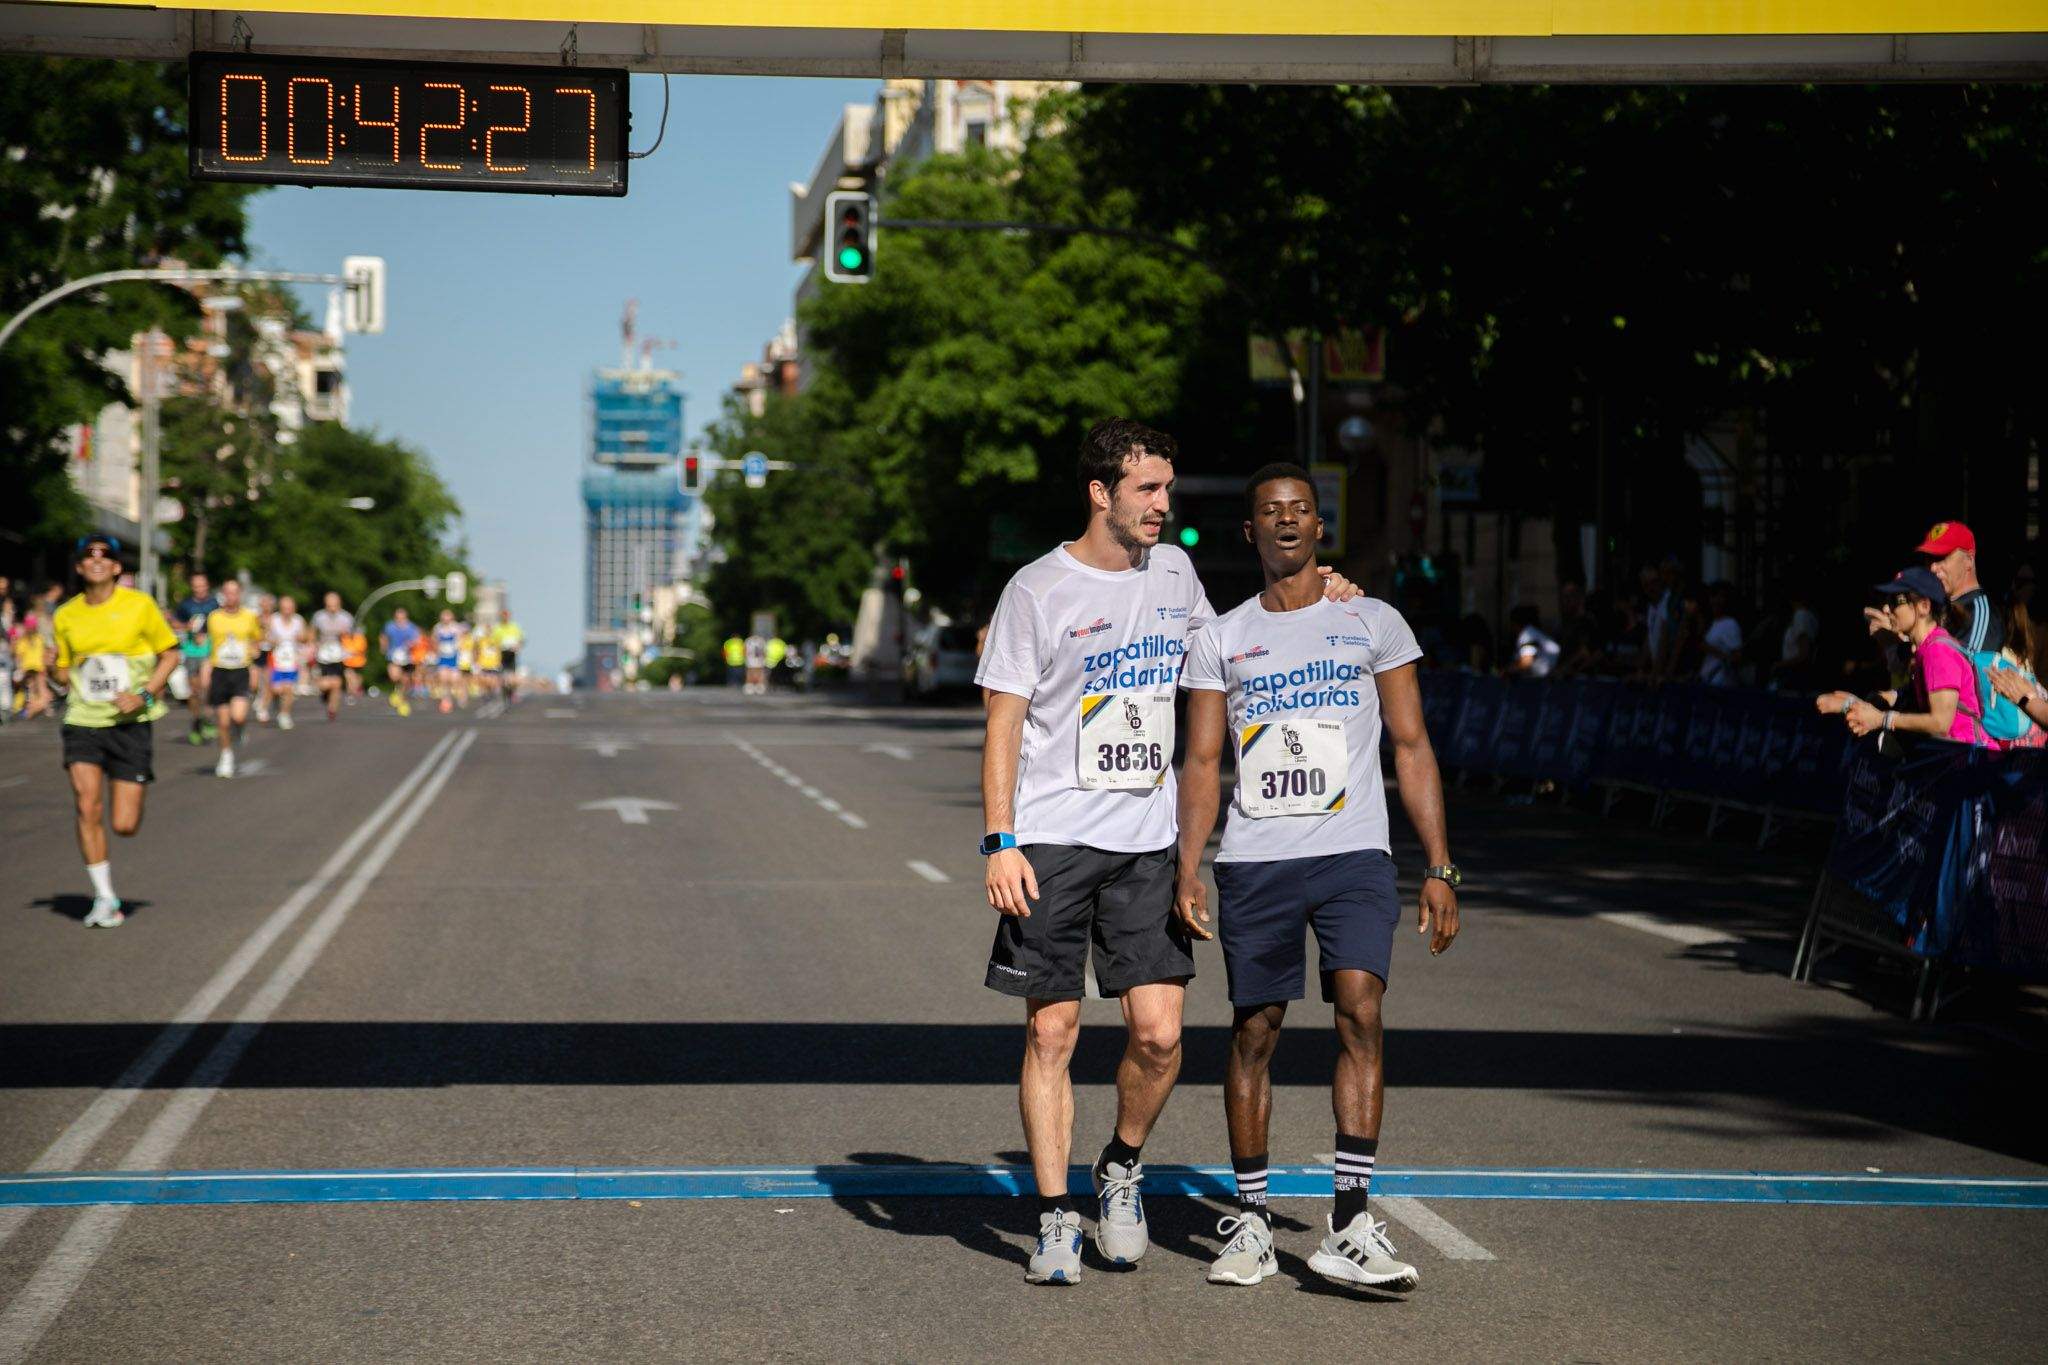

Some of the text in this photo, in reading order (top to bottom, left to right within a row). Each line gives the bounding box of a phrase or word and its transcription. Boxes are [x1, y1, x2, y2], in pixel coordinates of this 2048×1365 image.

[220, 73, 597, 173] 00:42:27
[1084, 634, 1184, 672] zapatillas
[1242, 659, 1362, 696] zapatillas
[1246, 685, 1360, 720] solidarias
[1098, 743, 1162, 772] 3836
[1261, 767, 1327, 800] 3700
